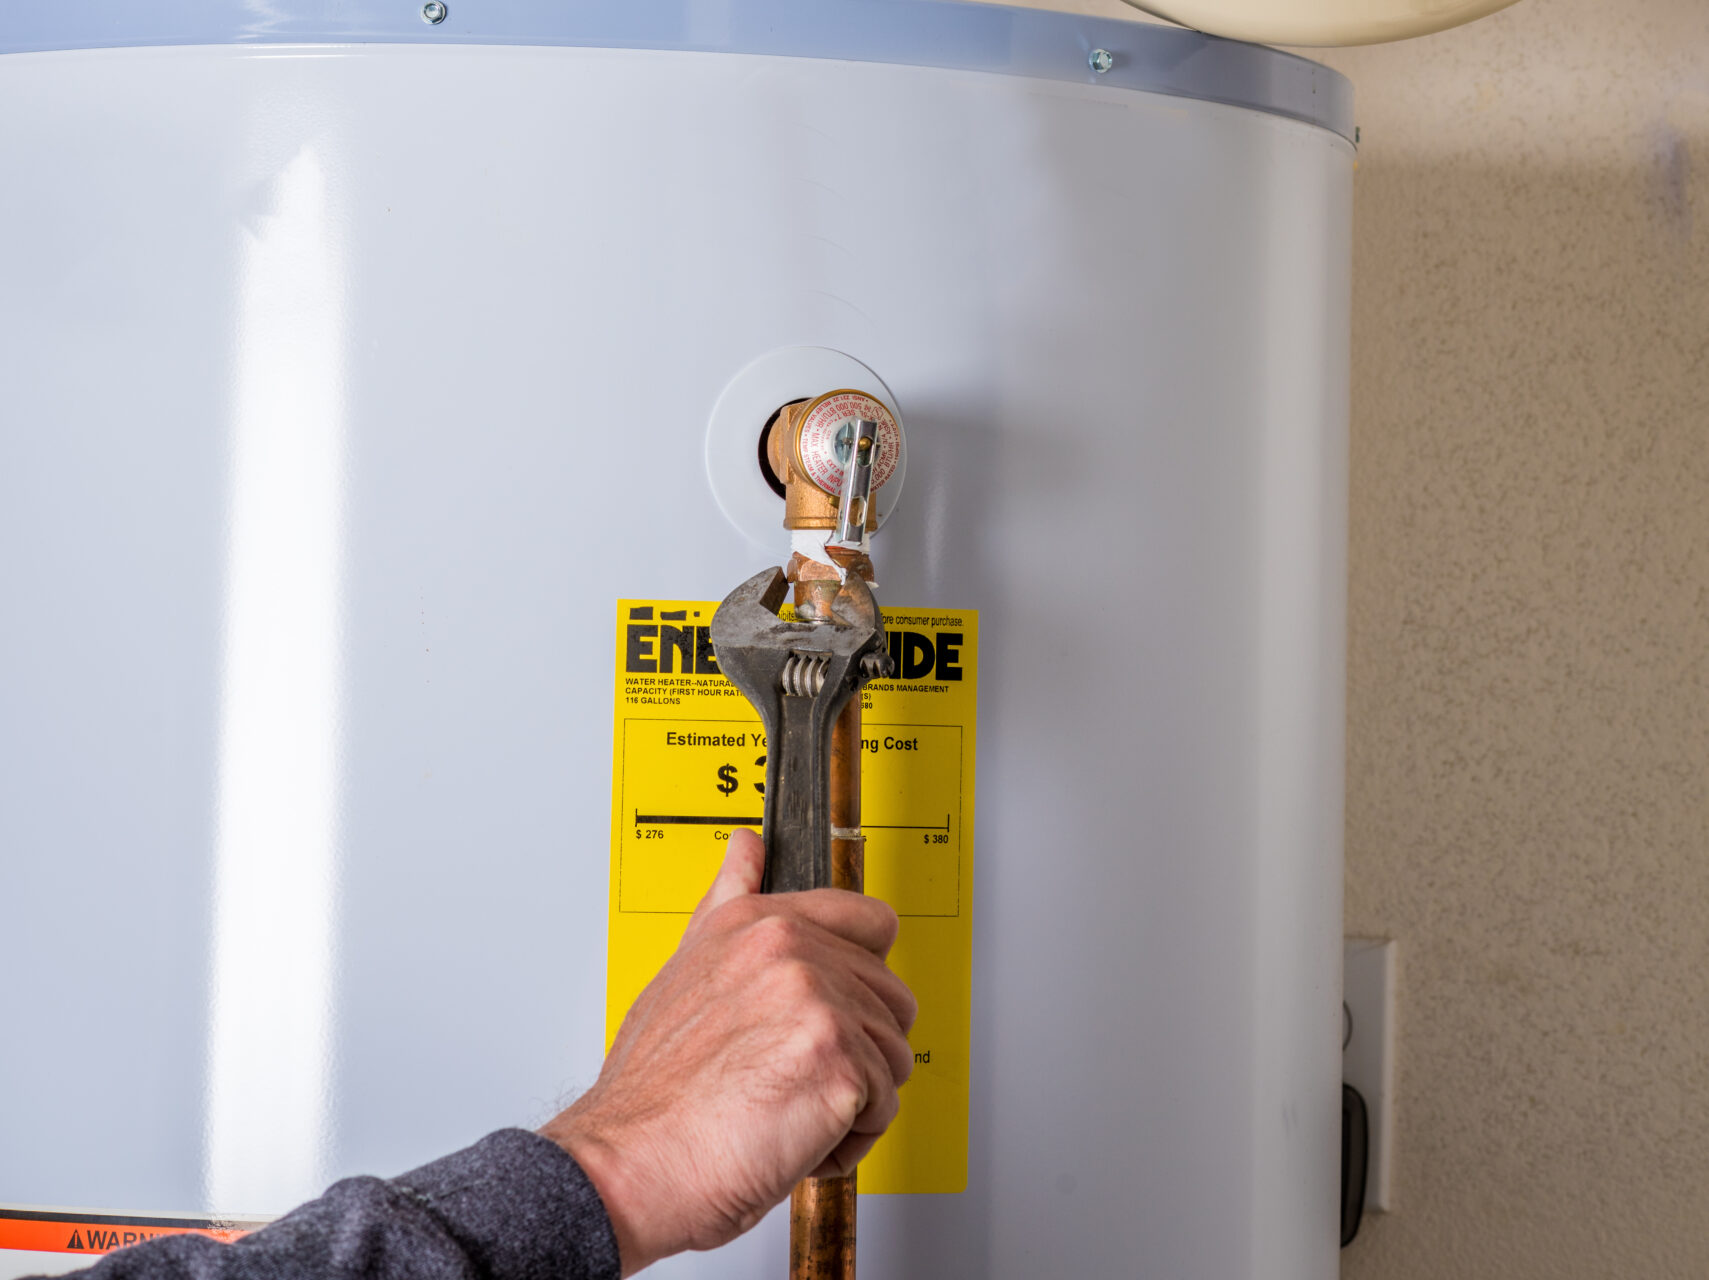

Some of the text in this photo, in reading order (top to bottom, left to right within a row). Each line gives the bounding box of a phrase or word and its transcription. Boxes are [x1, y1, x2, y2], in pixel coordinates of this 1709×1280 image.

[816, 401, 832, 414] RELIEF
[806, 414, 816, 432] VALVES
[813, 450, 827, 476] HEATER
[826, 474, 843, 487] INPU
[815, 476, 835, 493] THERMAL
[625, 678, 656, 686] WATER
[896, 684, 949, 693] MANAGEMENT
[625, 687, 667, 696] CAPACITY
[669, 688, 696, 696] (FIRST
[697, 688, 722, 697] HOUR
[640, 697, 681, 705] GALLONS
[666, 731, 746, 747] Estimated
[884, 736, 919, 751] Cost
[716, 763, 739, 797] $
[645, 830, 664, 839] 276
[932, 834, 949, 844] 380
